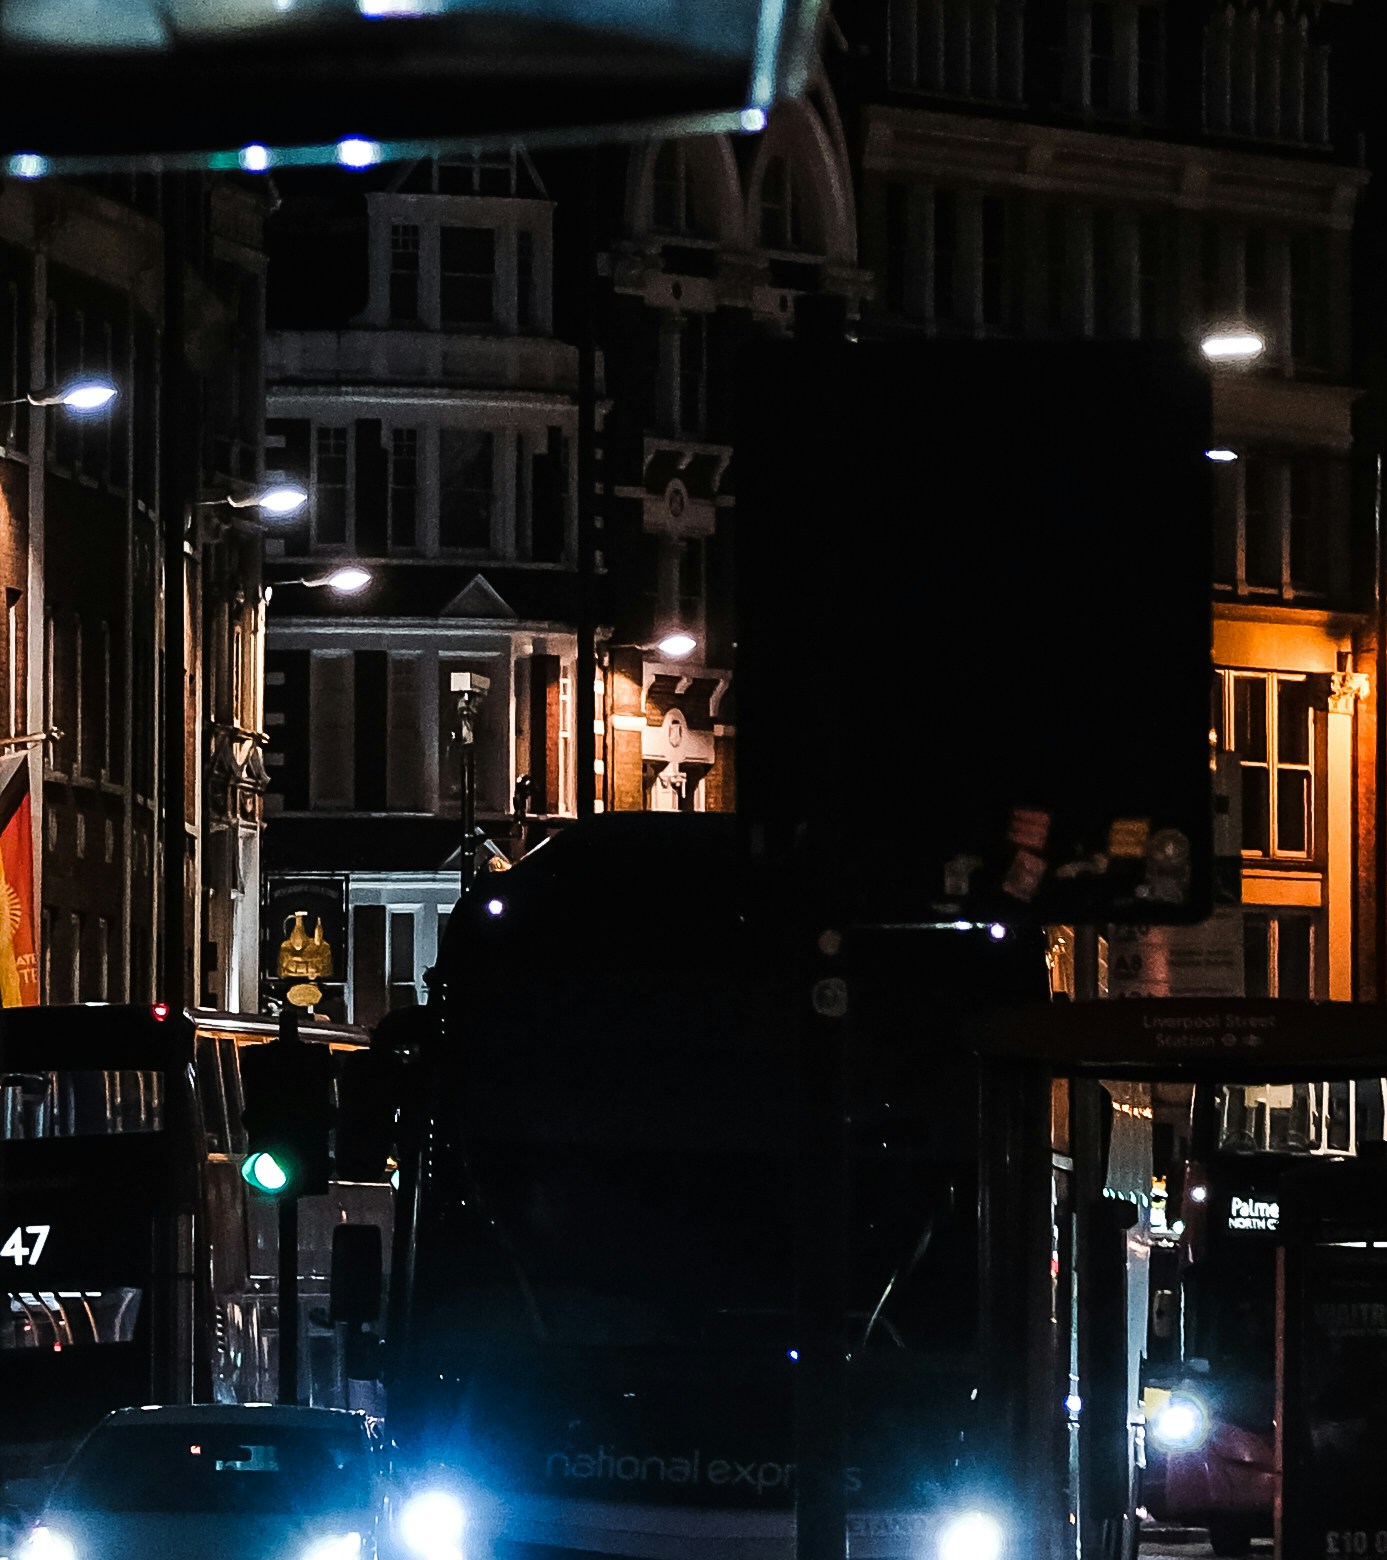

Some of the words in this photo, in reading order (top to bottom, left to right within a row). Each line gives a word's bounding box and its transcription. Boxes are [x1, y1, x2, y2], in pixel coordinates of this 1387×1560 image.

[1142, 1013, 1221, 1030] Liverpool
[1226, 1013, 1276, 1028] Street
[1155, 1032, 1215, 1047] Station
[1228, 1217, 1266, 1230] NORTH
[1267, 1218, 1280, 1230] C
[0, 1224, 51, 1267] 47
[546, 1445, 701, 1483] national
[706, 1457, 863, 1496] exprs
[1325, 1530, 1369, 1554] £10
